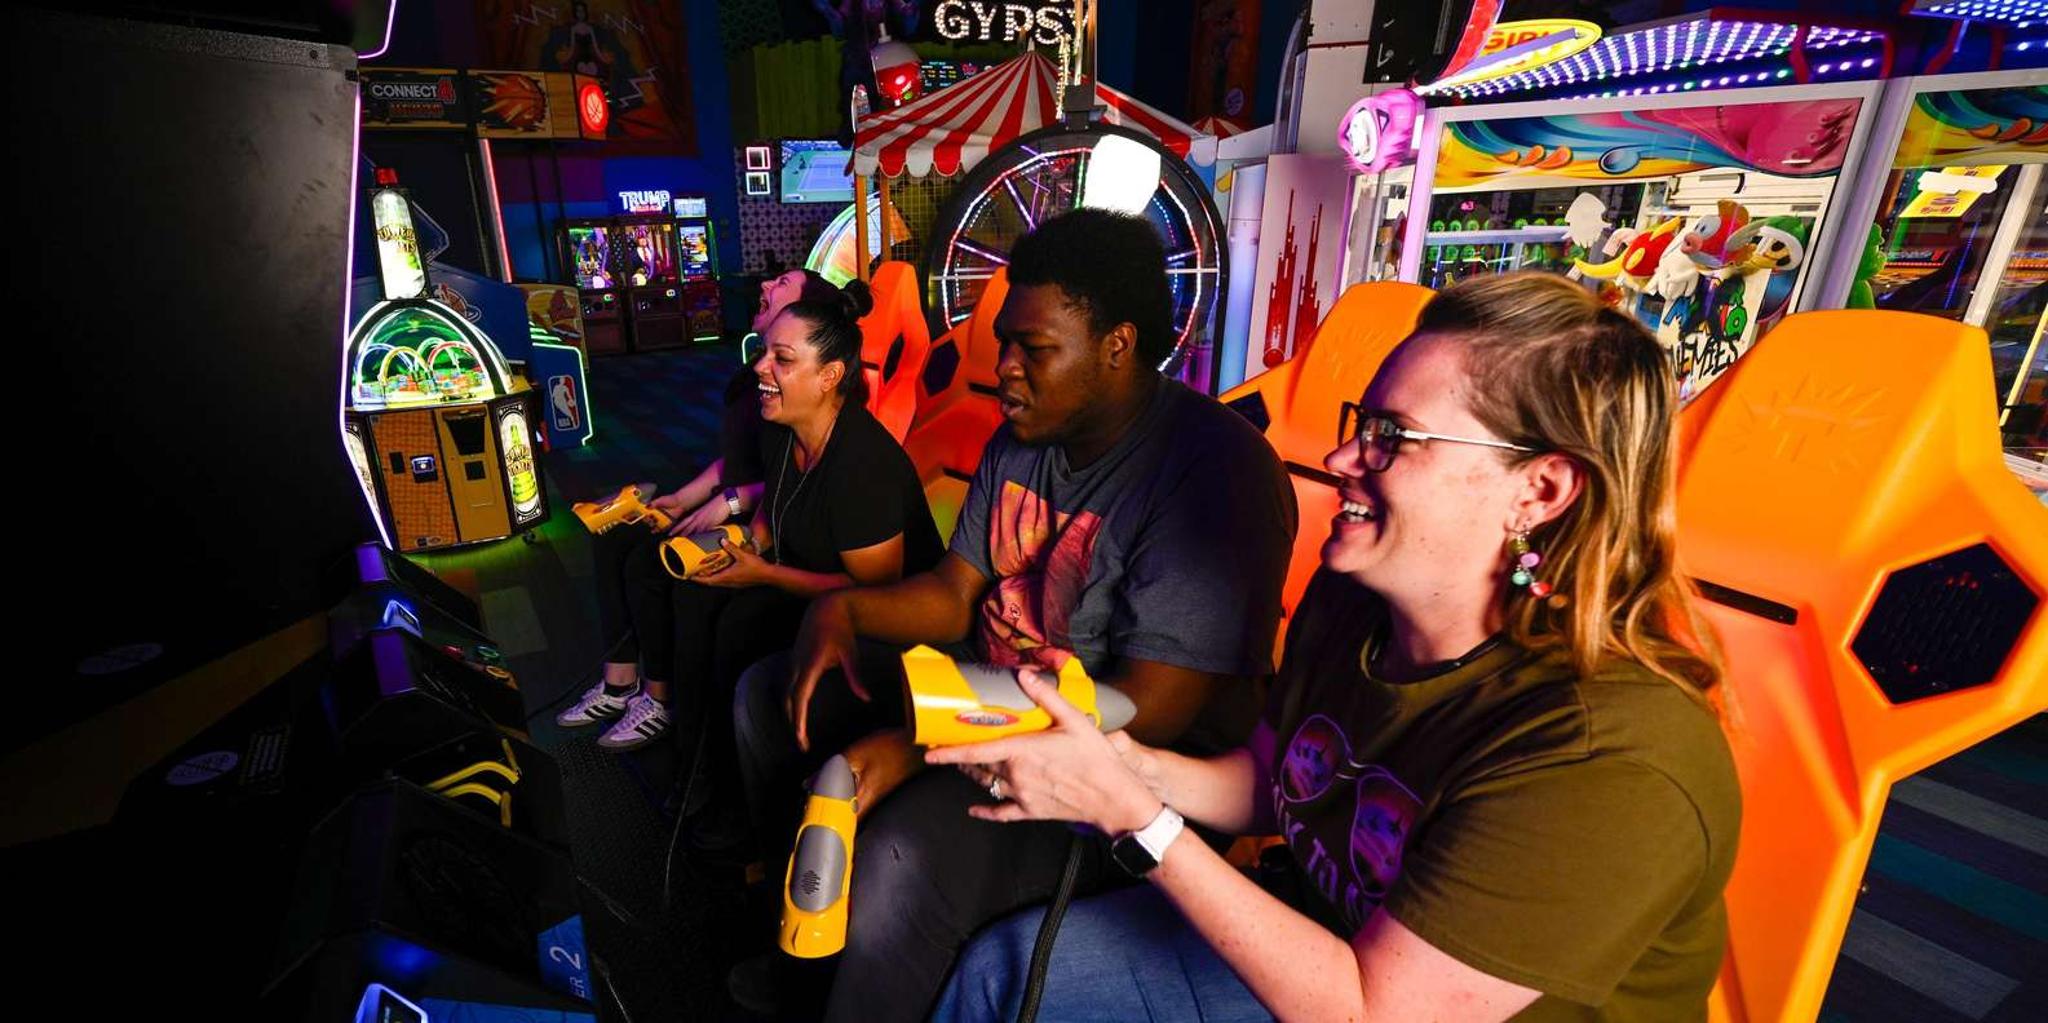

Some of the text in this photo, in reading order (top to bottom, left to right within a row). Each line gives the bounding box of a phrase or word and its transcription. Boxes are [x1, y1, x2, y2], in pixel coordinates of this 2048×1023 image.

[934, 0, 1088, 44] GYPSY
[371, 84, 437, 98] CONNECT
[619, 190, 670, 210] TRUMP
[1666, 338, 1740, 381] NEMIES
[549, 945, 581, 970] 2
